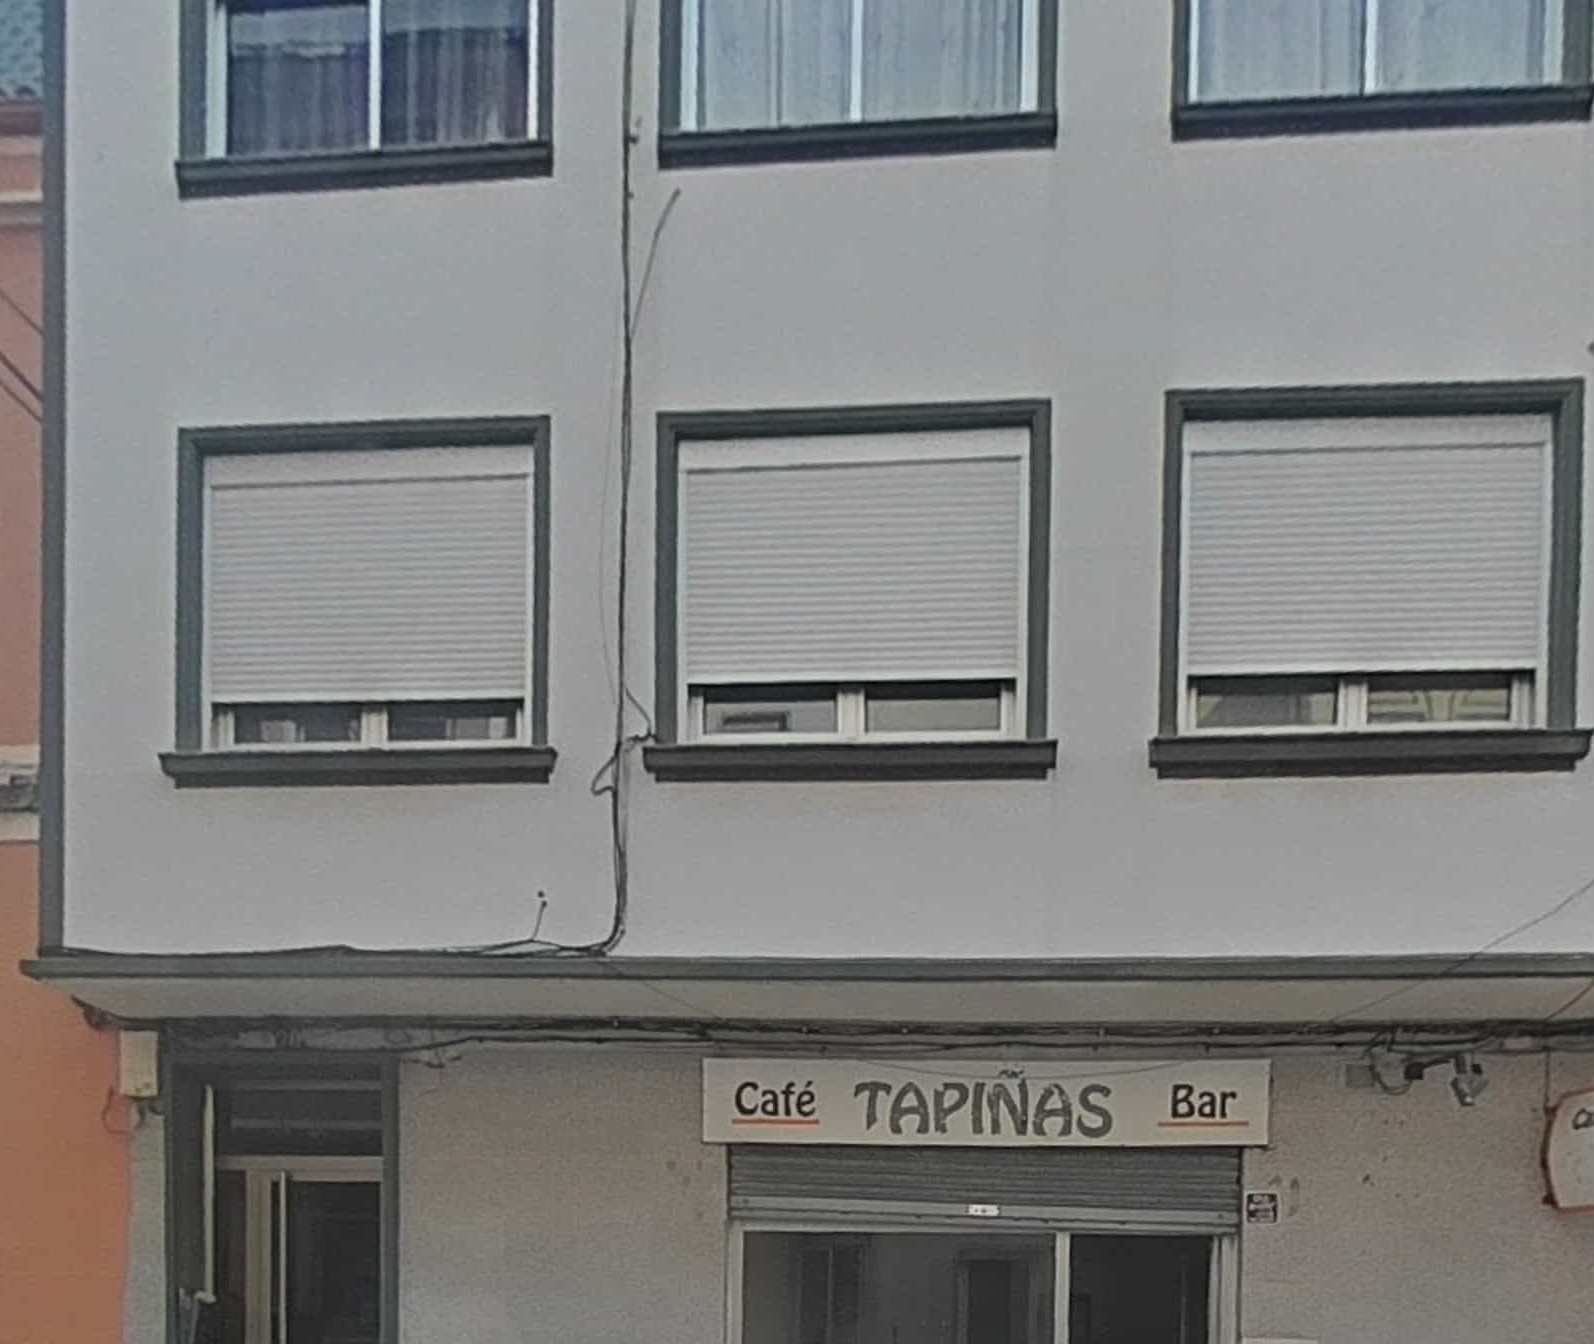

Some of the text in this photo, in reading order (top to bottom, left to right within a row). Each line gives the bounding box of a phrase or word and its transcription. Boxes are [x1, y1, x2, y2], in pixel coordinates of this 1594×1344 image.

[734, 1069, 1237, 1138] Café TAPIÑAS Bar
